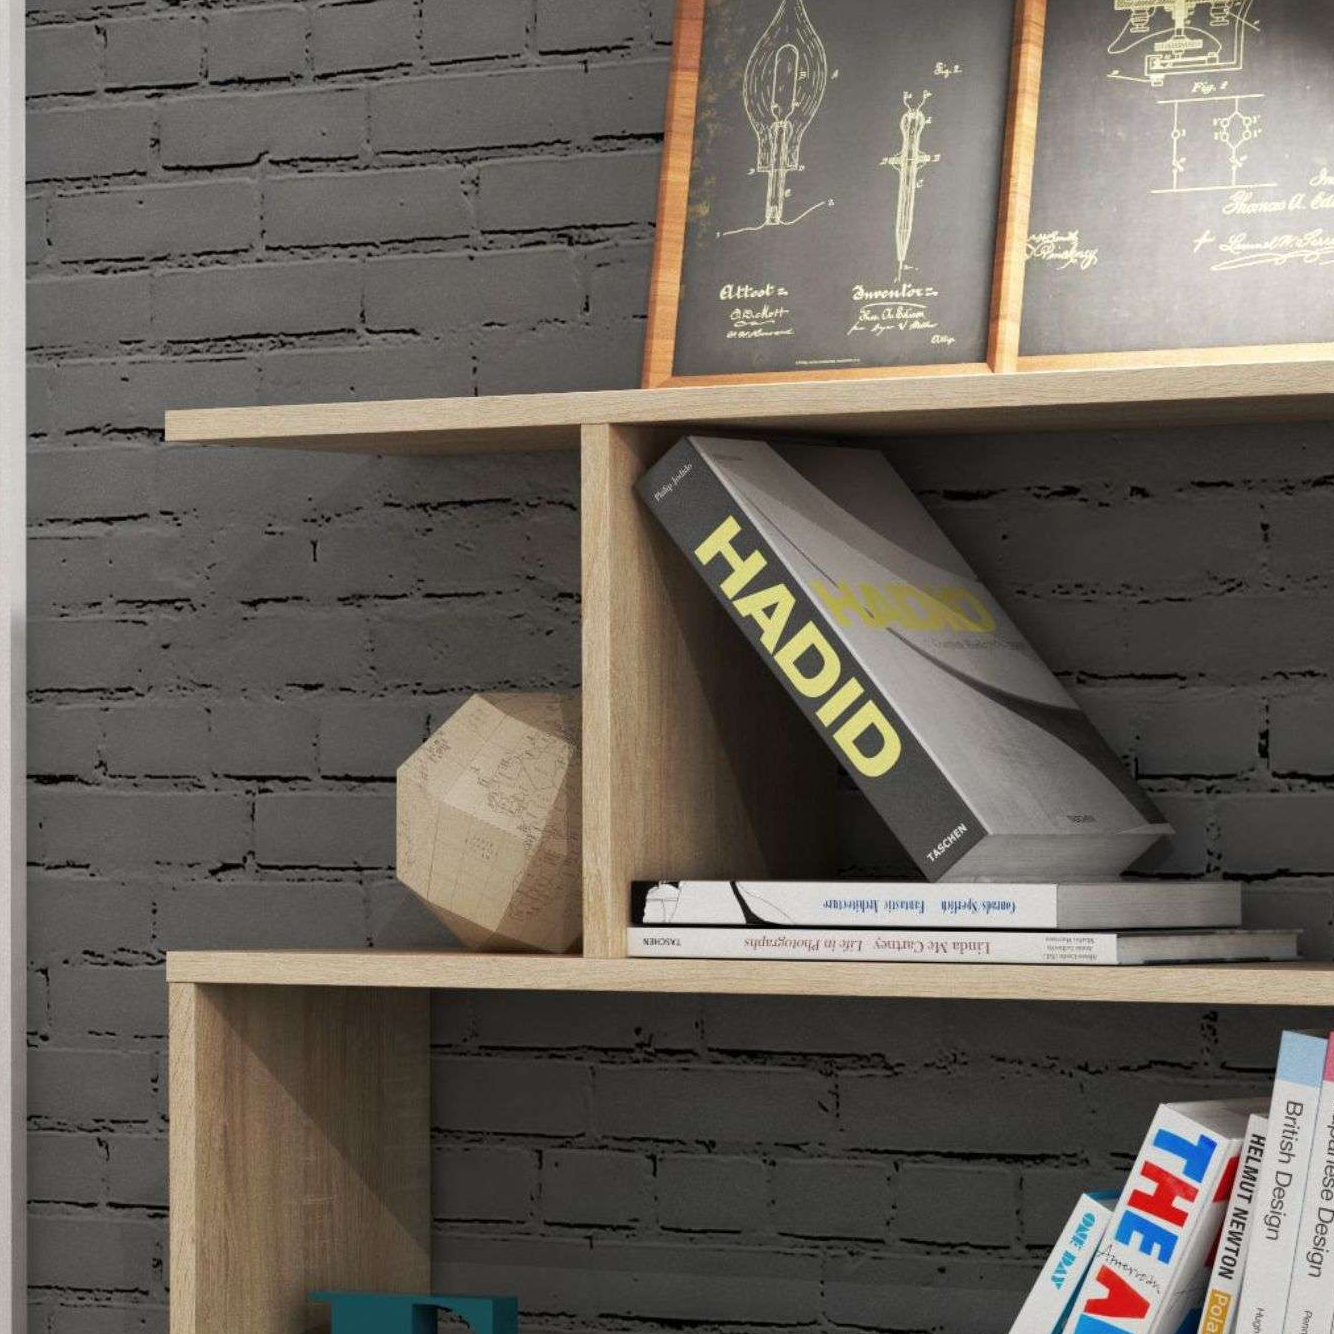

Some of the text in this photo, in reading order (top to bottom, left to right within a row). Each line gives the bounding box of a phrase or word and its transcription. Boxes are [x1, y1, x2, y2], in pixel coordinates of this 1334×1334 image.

[811, 579, 996, 633] HADID
[694, 515, 902, 778] HADID
[926, 823, 967, 862] TASCHEN
[823, 900, 878, 913] Architecture
[886, 900, 924, 914] Fantastic
[643, 938, 680, 946] TASCHEN
[745, 936, 990, 955] Linda Mc Cartney Life in Photographs
[1114, 1127, 1218, 1266] THE
[1237, 1134, 1266, 1203] HELMUT
[1264, 1101, 1303, 1240] British Design
[1051, 1213, 1095, 1290] ONE DAY
[1218, 1207, 1248, 1279] NEWTON
[1306, 1207, 1334, 1277] Design
[1252, 1308, 1265, 1333] Hugh
